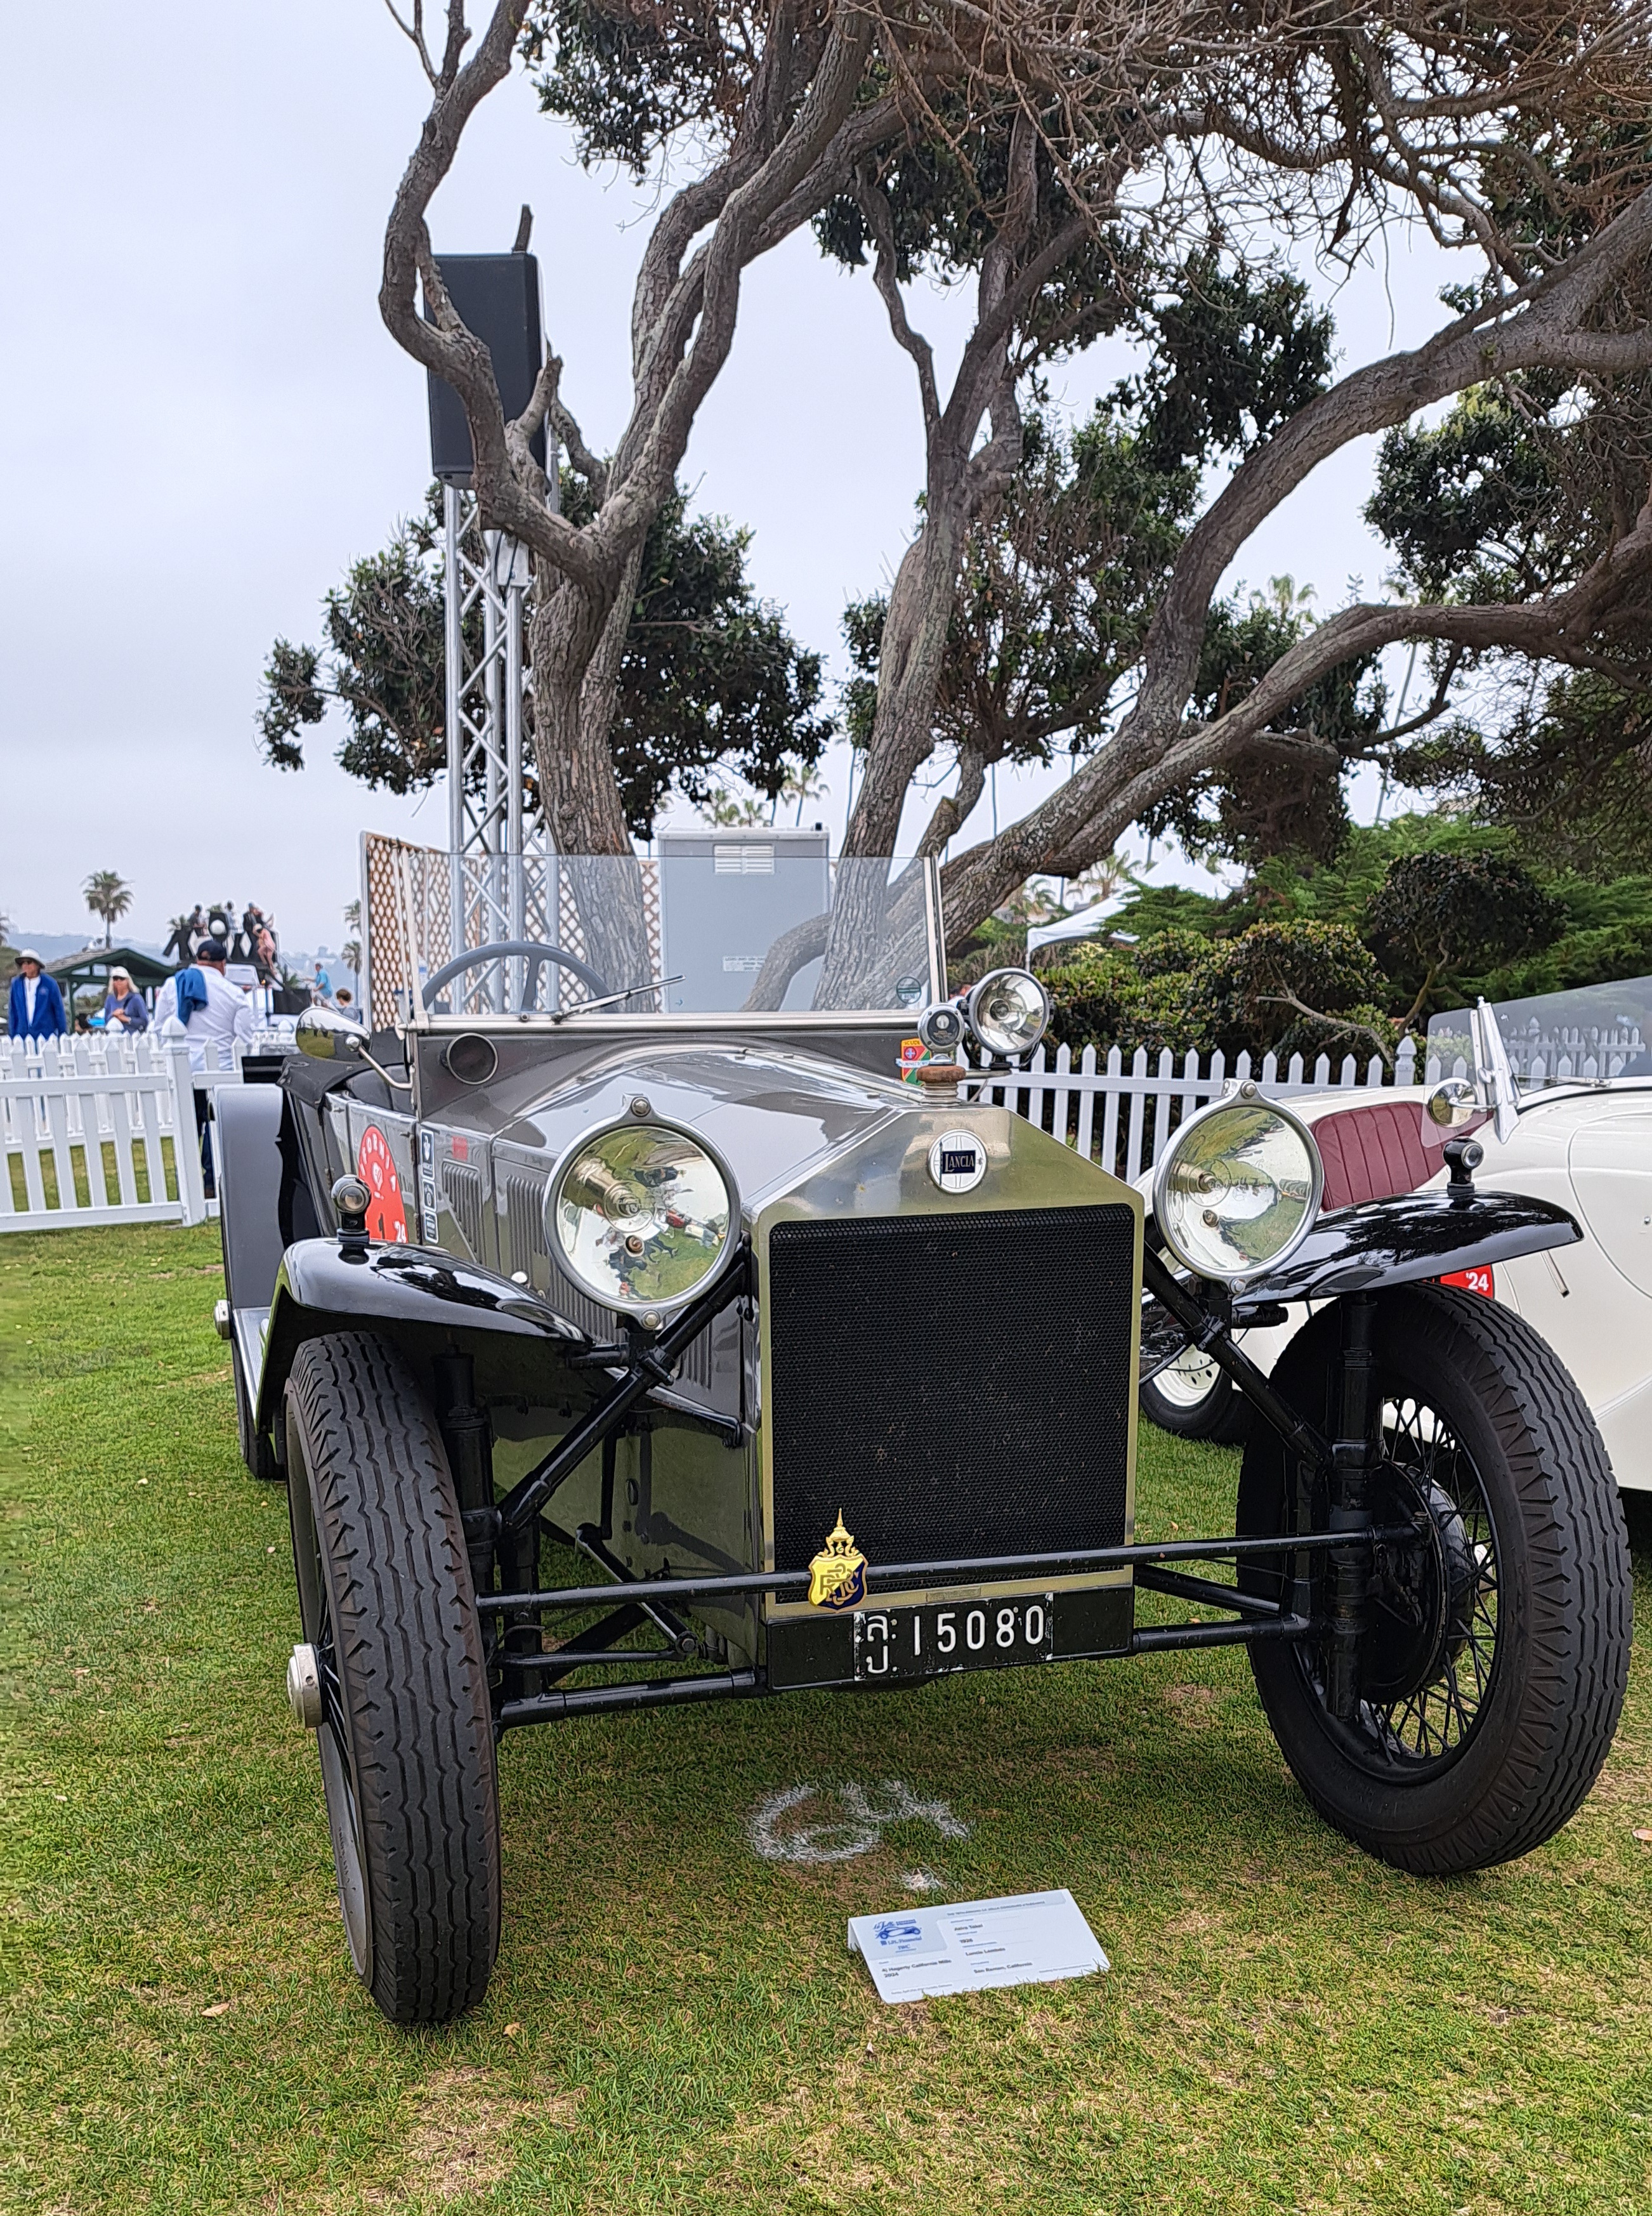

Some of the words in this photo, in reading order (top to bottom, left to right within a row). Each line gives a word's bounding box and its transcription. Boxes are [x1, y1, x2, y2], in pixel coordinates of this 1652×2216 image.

[944, 1153, 974, 1172] LANCIA
[1465, 1271, 1489, 1291] '24
[912, 1605, 1045, 1656] 15080
